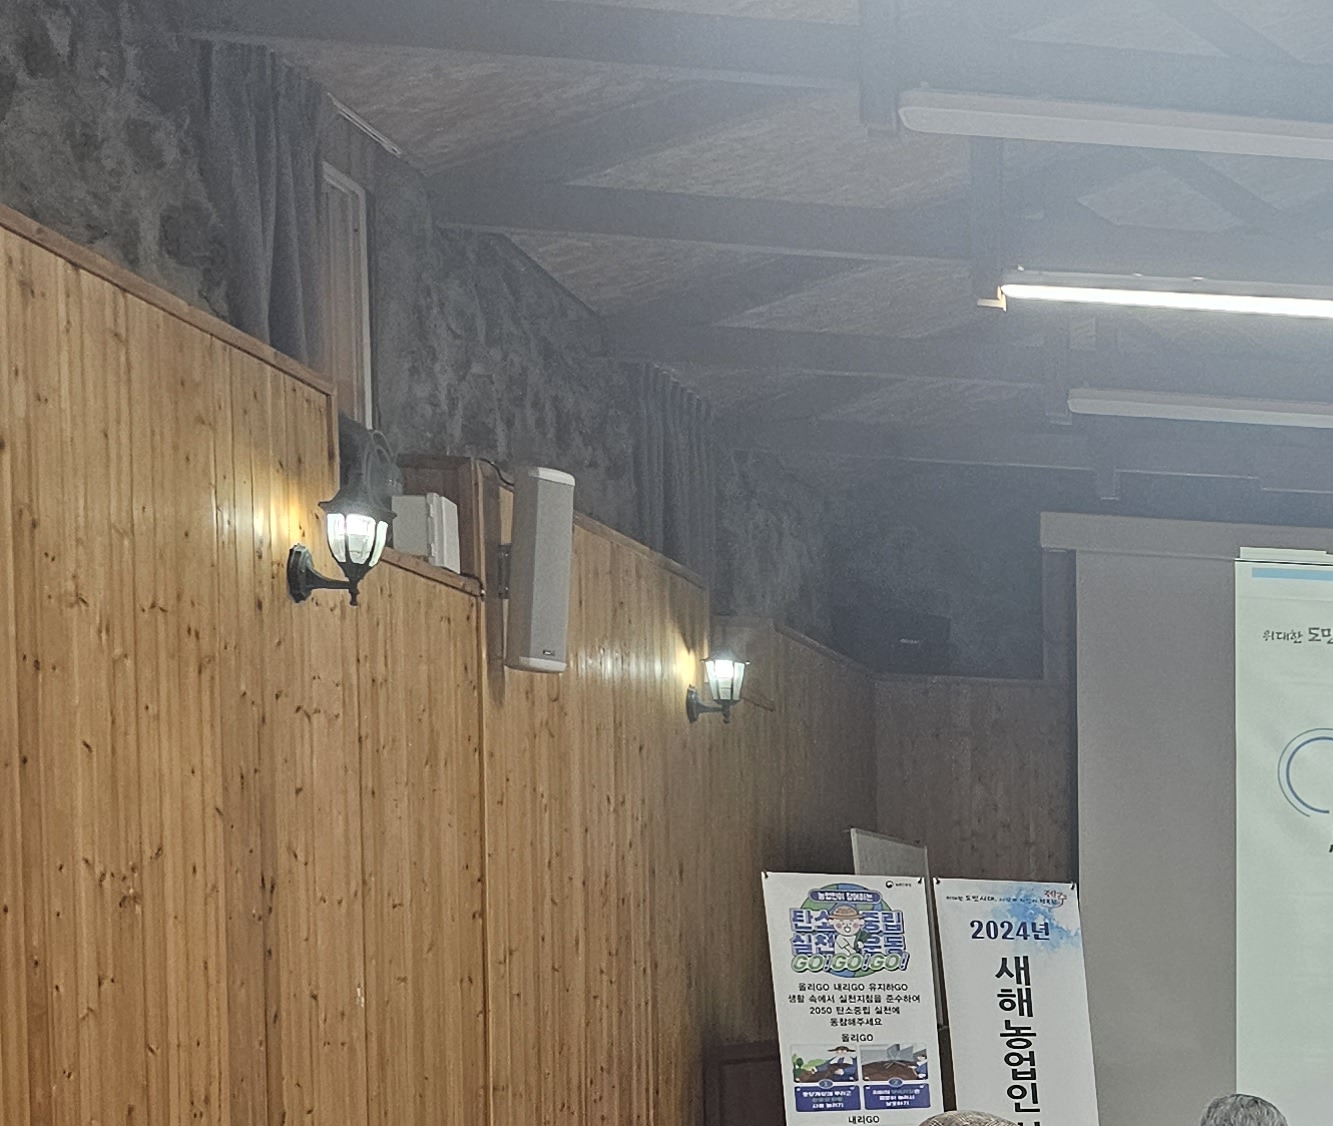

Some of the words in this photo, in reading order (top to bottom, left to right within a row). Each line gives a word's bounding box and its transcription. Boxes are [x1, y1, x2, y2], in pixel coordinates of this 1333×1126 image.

[1262, 629, 1303, 644] 위대한
[969, 919, 1051, 941] 2024년
[798, 983, 830, 992] 올리GO
[833, 983, 865, 992] 내리GO
[868, 983, 909, 992] 유지하GO
[809, 1007, 833, 1015] 2050
[836, 1006, 871, 1015] 탄소중립
[841, 1034, 874, 1043] 올리GO
[848, 1115, 880, 1124] 내리GO
